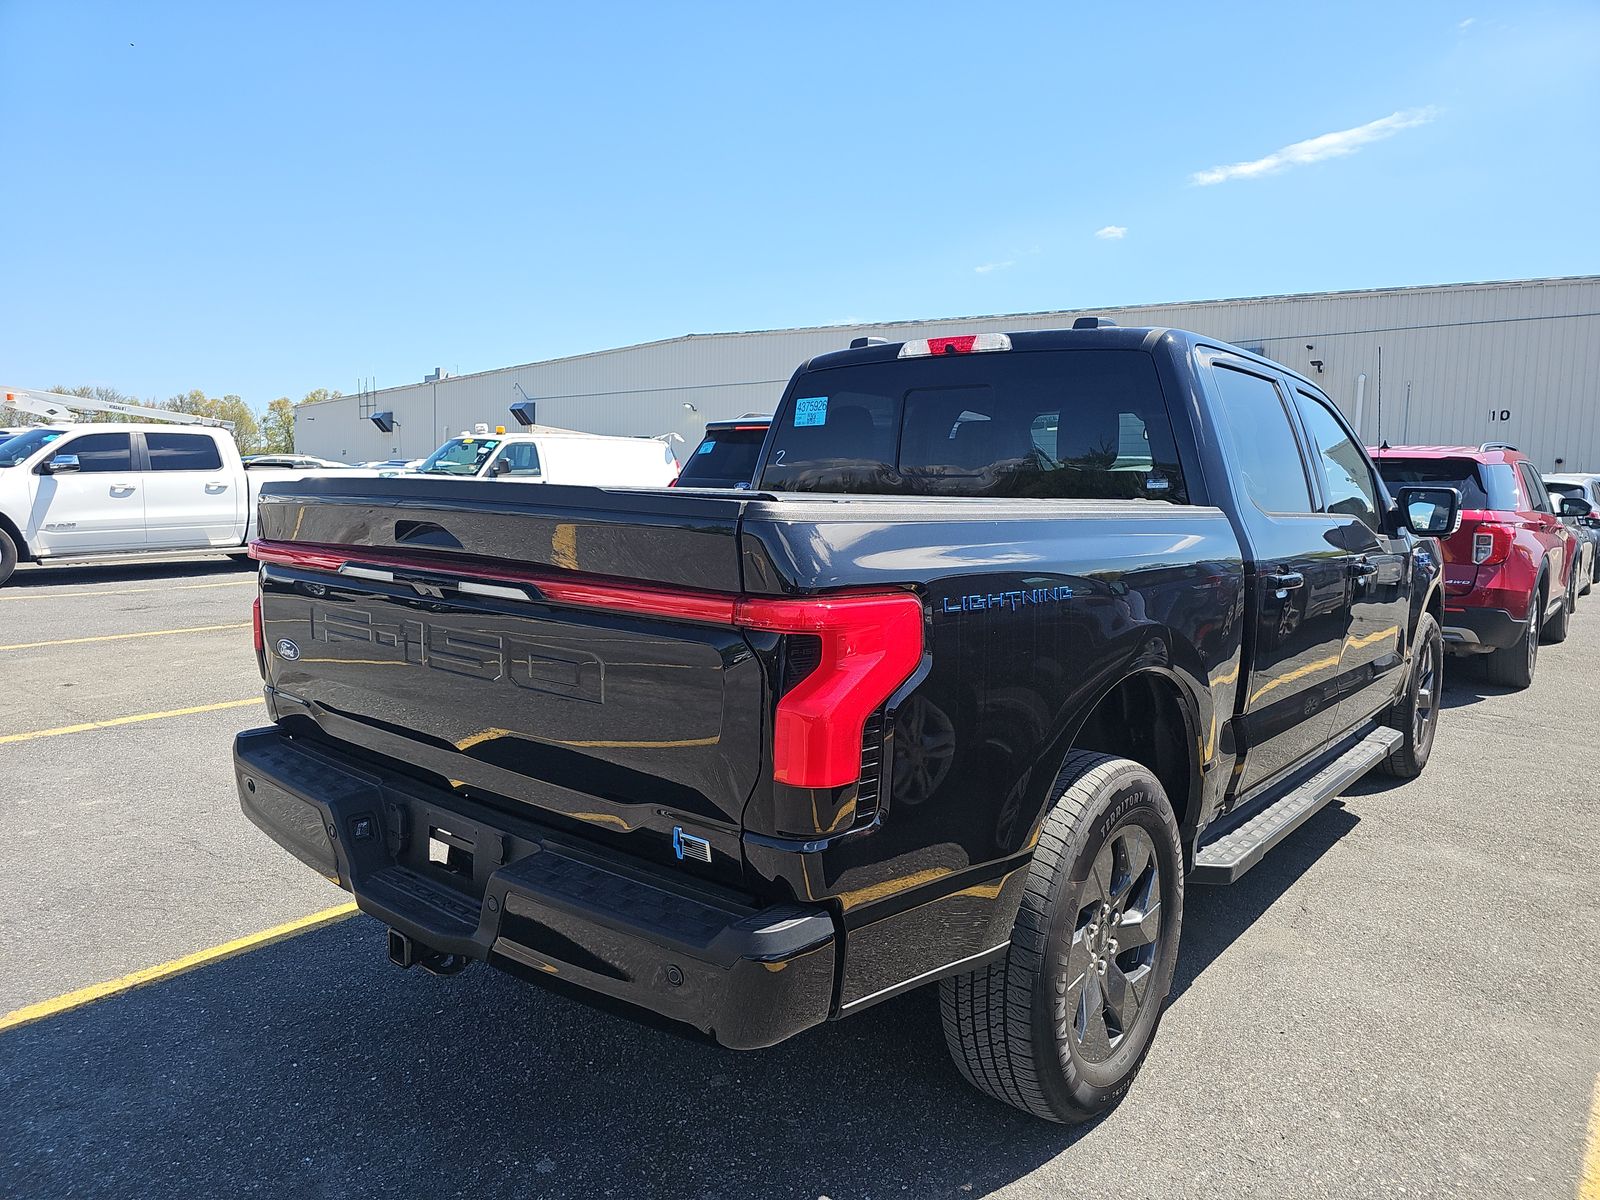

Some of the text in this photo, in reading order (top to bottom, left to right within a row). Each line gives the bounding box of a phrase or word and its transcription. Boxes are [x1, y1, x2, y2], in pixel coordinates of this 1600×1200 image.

[797, 400, 827, 412] 4375926
[1491, 410, 1511, 421] 10
[775, 449, 787, 467] 2
[943, 586, 1073, 613] LIGHTNING
[1100, 791, 1145, 838] TERRITORY
